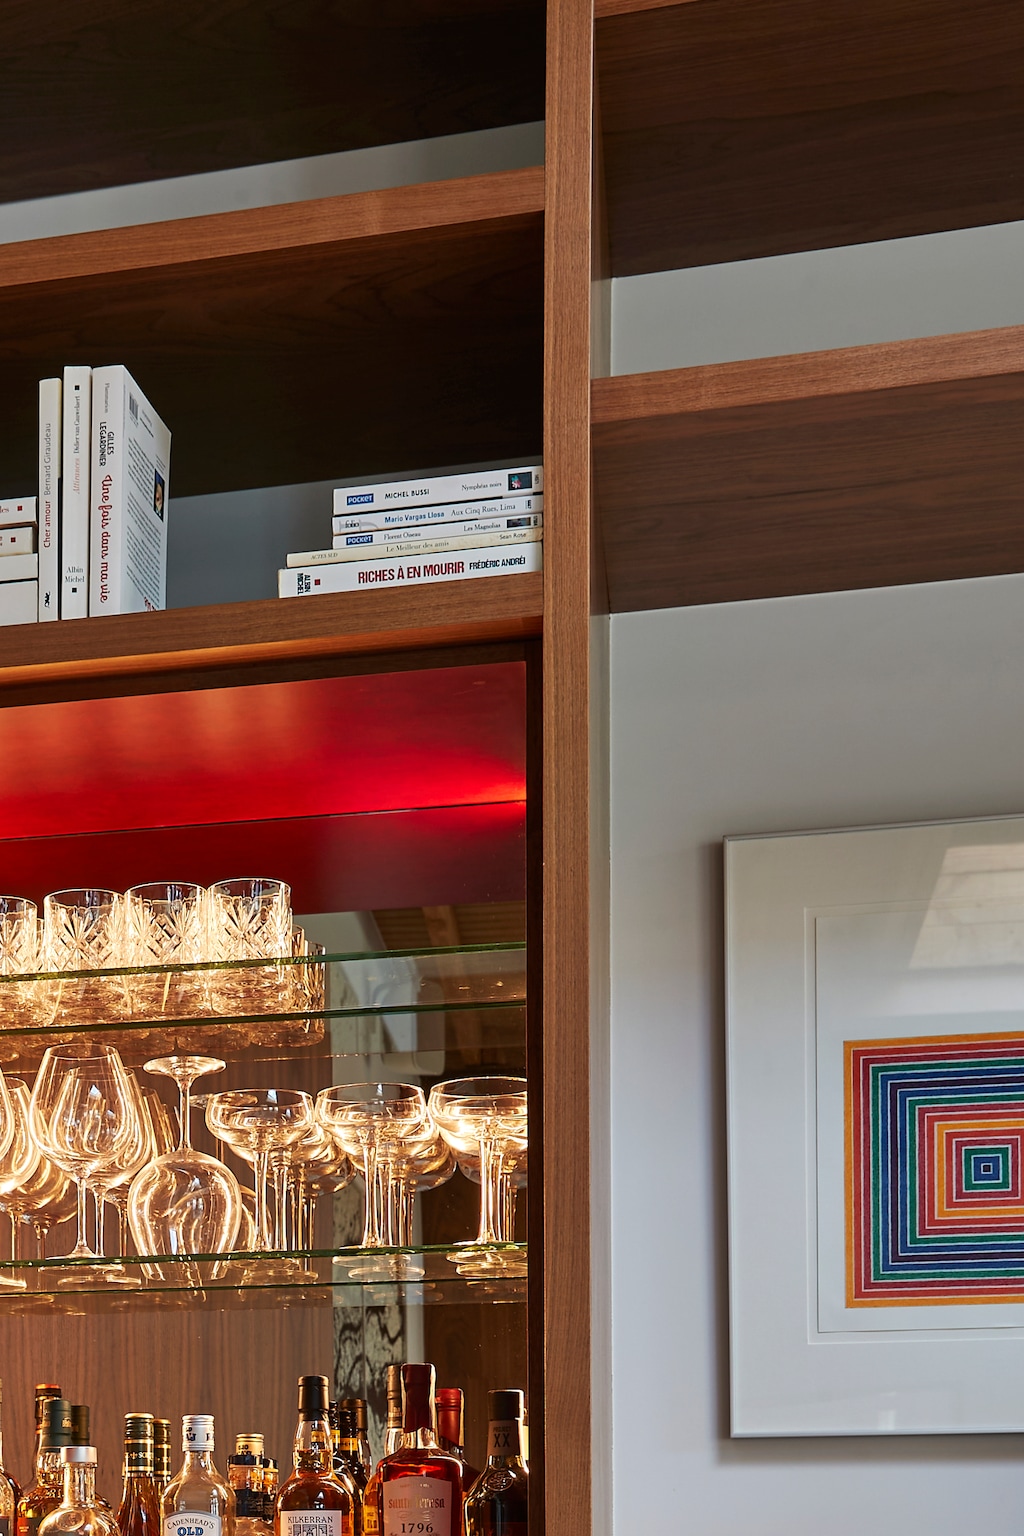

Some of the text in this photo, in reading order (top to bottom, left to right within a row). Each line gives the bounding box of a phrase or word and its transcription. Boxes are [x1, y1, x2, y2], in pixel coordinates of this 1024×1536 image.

[107, 431, 115, 455] GILLES
[385, 490, 409, 499] MICHEL
[411, 488, 429, 496] BUSSI
[345, 520, 359, 528] folio
[404, 514, 426, 522] Vargas
[465, 507, 480, 515] Cinq
[43, 529, 51, 548] Cher
[98, 474, 112, 603] Une fois dans ma vie
[395, 541, 420, 550] Meilleur
[358, 555, 526, 584] RICHES À EN MOURIR FRÉDÉRIC ANDRÉI
[494, 1433, 510, 1447] XX
[167, 1518, 215, 1529] CADENHEAD'S
[401, 1522, 433, 1533] 1796
[177, 1526, 204, 1536] OLD
